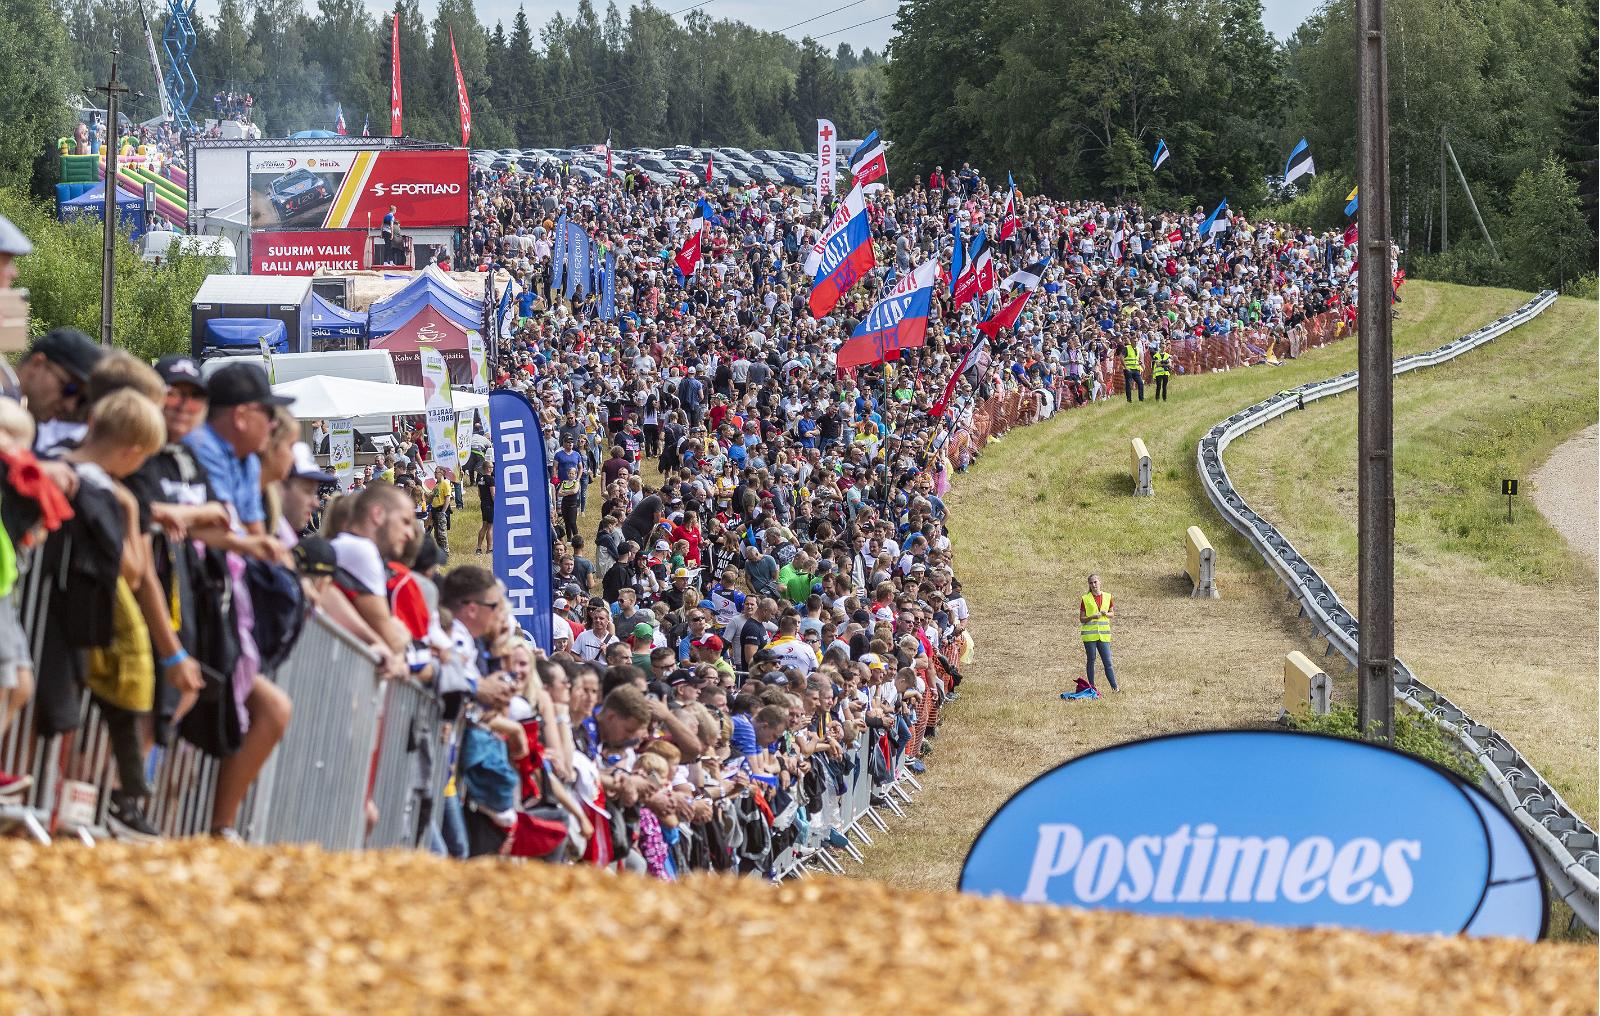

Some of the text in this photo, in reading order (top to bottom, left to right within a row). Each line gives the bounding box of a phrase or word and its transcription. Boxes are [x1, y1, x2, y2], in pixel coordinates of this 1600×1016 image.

[391, 183, 461, 195] SPORTLAND
[268, 245, 352, 257] SUURIM VALIK
[261, 262, 292, 272] RALLI
[339, 326, 360, 335] saku
[395, 354, 413, 362] Kohv
[1021, 823, 1422, 908] Postimees
